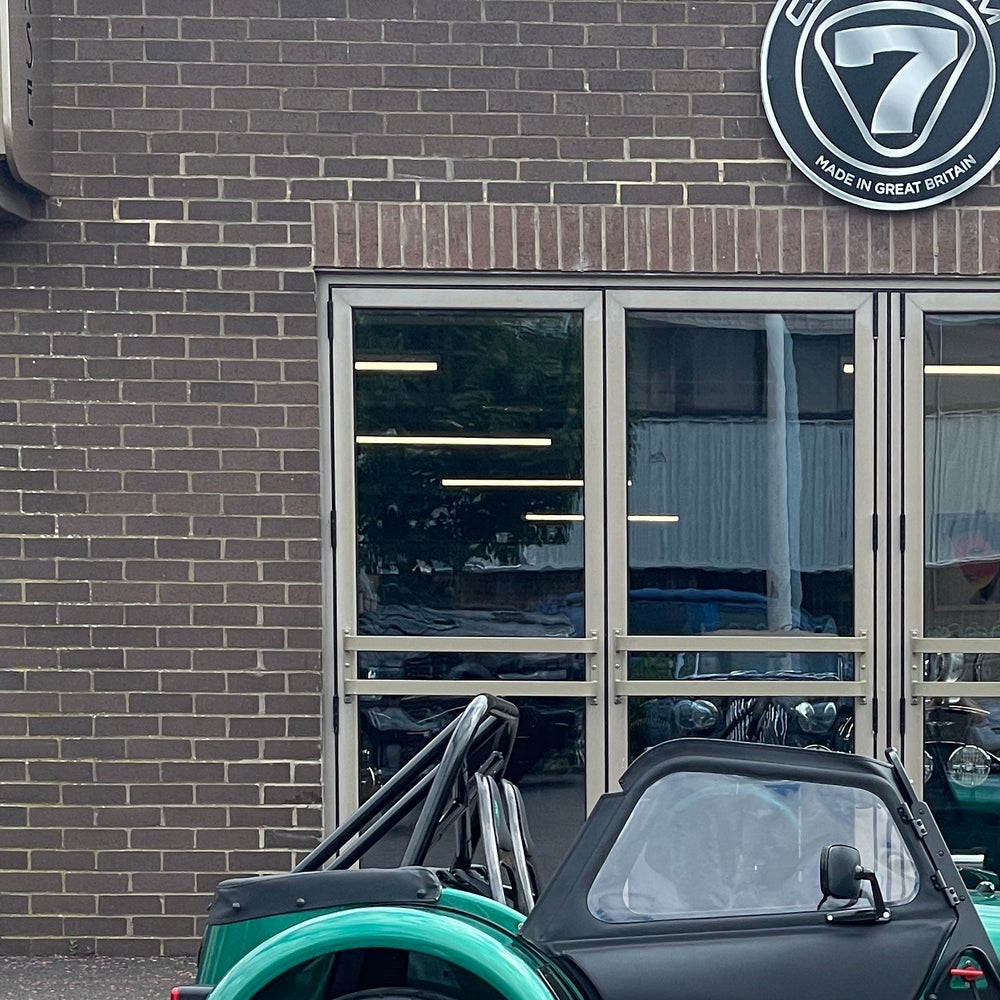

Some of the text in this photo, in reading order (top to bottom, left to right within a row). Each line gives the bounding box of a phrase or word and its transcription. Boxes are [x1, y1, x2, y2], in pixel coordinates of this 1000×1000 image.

[835, 25, 957, 133] 7
[814, 154, 977, 195] MADE IN GREAT BRITAIN
